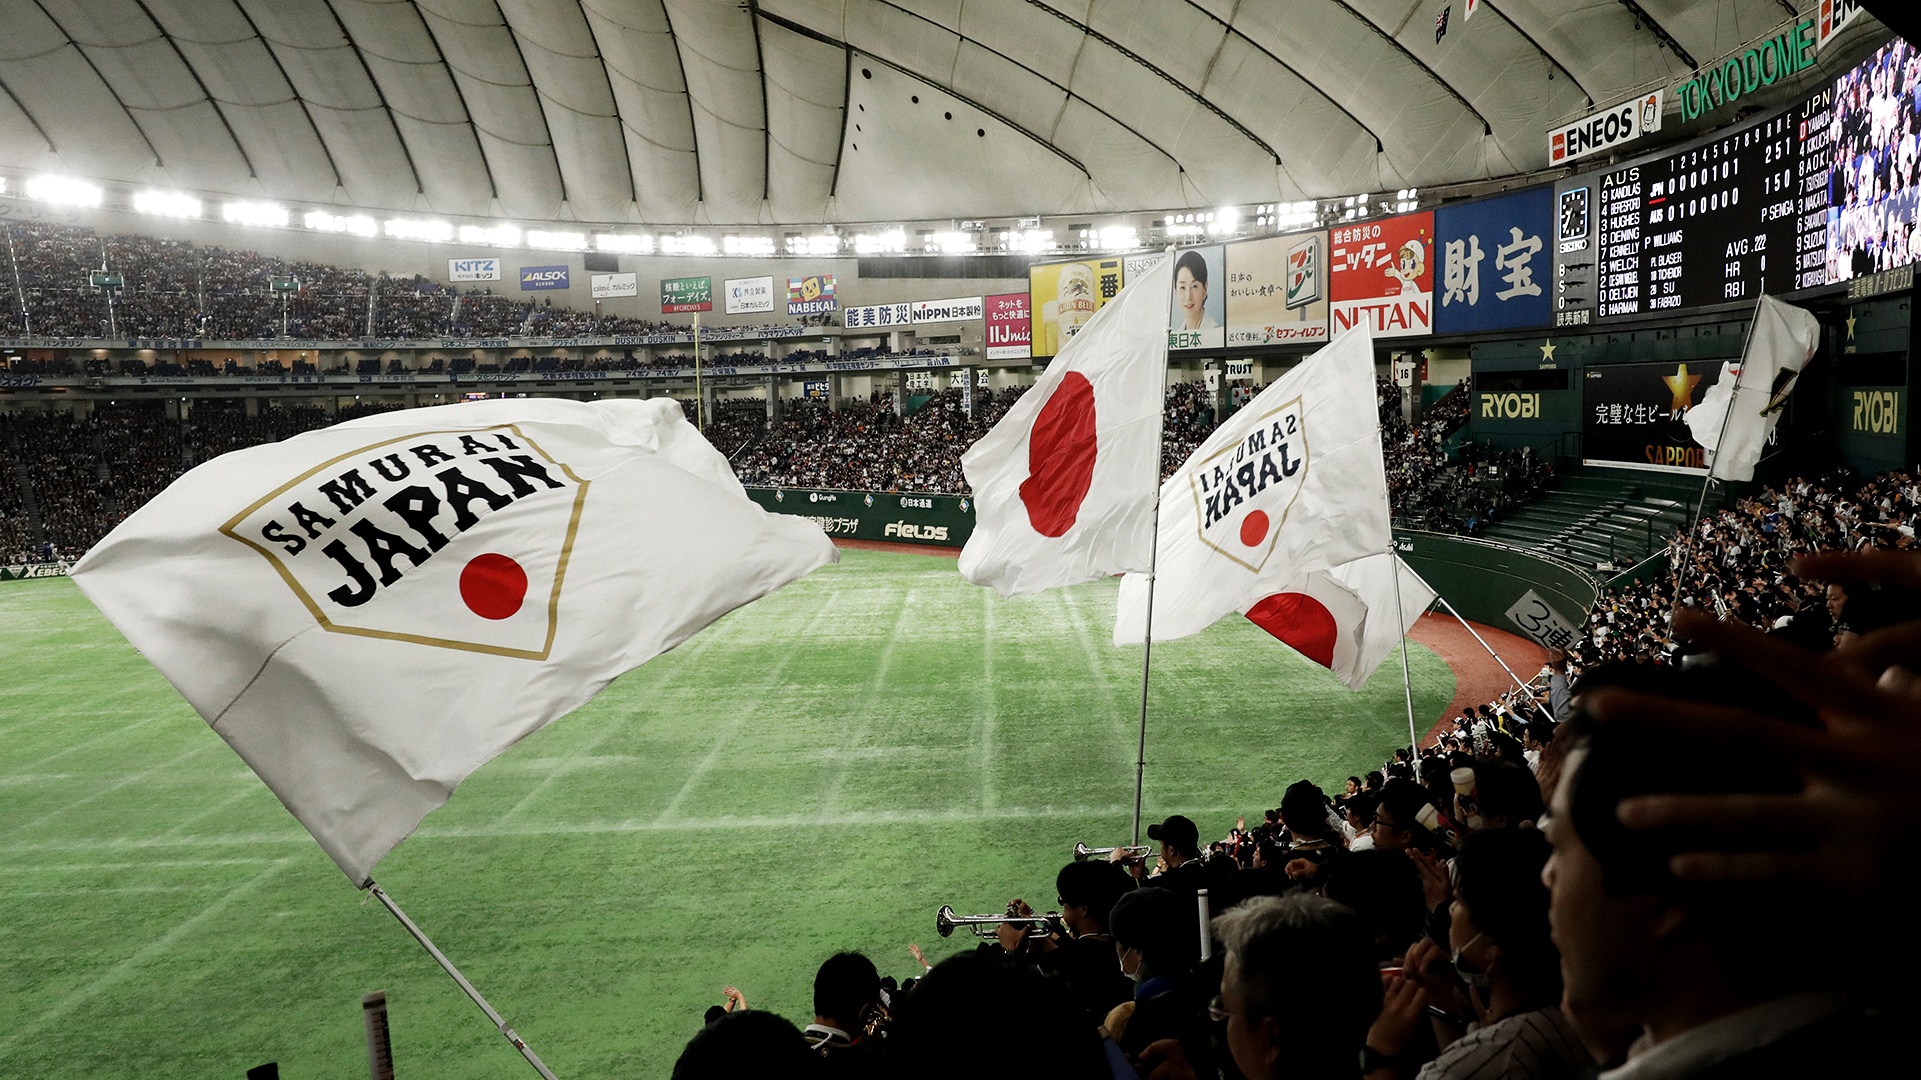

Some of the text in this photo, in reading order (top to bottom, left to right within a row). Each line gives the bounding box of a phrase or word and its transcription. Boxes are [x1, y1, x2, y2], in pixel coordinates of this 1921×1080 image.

[1675, 18, 1817, 124] TOKYO DOME
[1801, 87, 1830, 119] JPN
[1808, 109, 1830, 134] YAMADA
[1567, 107, 1632, 157] ENEOS
[1670, 113, 1792, 172] 1 2 3 4 5 6 7 8 9 R E
[1799, 141, 1805, 157] 4
[1650, 137, 1791, 198] JPN 0 0 0 0 1 0 1 2 5 1
[1799, 148, 1829, 176] 8 AOKI
[1603, 167, 1640, 188] AUS
[1601, 182, 1641, 203] 9 KANDILAS
[1650, 169, 1791, 224] AUS 0 1 0 0 0 0 0 1 5 0
[1798, 179, 1804, 196] 7
[1601, 197, 1640, 217] 4 BERESFORD
[1761, 199, 1794, 222] P SENGA
[1798, 189, 1827, 214] 3 NAKATA
[1601, 212, 1640, 231] 3 HUGHES
[1797, 217, 1803, 234] 6
[1334, 225, 1381, 245] 総合防災の
[1601, 226, 1639, 245] 8 DENING
[1644, 230, 1683, 250] P WILLIAMS
[1796, 229, 1826, 252] 9 SUZUKI
[1560, 239, 1588, 253] SEIKO
[1601, 241, 1639, 260] 7 KENNELLY
[1726, 233, 1766, 258] AVG .222
[455, 260, 494, 272] KITZ
[1333, 243, 1392, 272] ニッタン
[1600, 256, 1639, 274] 5 WELCH
[1658, 251, 1682, 266] BLASER
[1725, 255, 1766, 278] HR 0
[1795, 255, 1801, 271] 5
[532, 271, 567, 280] ALSOK
[1442, 227, 1543, 307] 財宝
[1559, 264, 1565, 277] B
[1101, 261, 1117, 307] 一番
[1231, 272, 1252, 283] 日本の
[1559, 280, 1565, 293] S
[1600, 276, 1606, 288] 2
[1795, 274, 1800, 290] 2
[612, 283, 635, 291] カルミック
[1231, 284, 1283, 297] おいしい食卓へ
[1600, 286, 1638, 302] D OELTJEN
[1663, 282, 1675, 294] SU
[1725, 281, 1745, 298] RBI
[663, 291, 711, 304] フォーデイズ。
[741, 301, 770, 309] 日本カルミック
[998, 299, 1022, 309] ネットを
[1657, 294, 1682, 308] FABRIZIO
[789, 301, 836, 314] NABEKAI.
[847, 305, 908, 327] 能美防災
[914, 304, 950, 320] NIPPN
[952, 305, 981, 318] 日本製粉
[992, 309, 1030, 320] もっと快適に
[1599, 301, 1638, 316] 6 HARMAN
[1334, 300, 1428, 334] NITTAN
[1557, 310, 1589, 326] 読売新聞
[1210, 375, 1214, 384] 4
[1400, 369, 1408, 379] 16
[1481, 393, 1539, 418] RYOBI
[1853, 390, 1898, 434] RYOBI
[1645, 445, 1704, 468] SAPPOR
[262, 433, 520, 557] SAMURAI
[819, 494, 836, 502] GungHo
[321, 455, 566, 607] JAPAN
